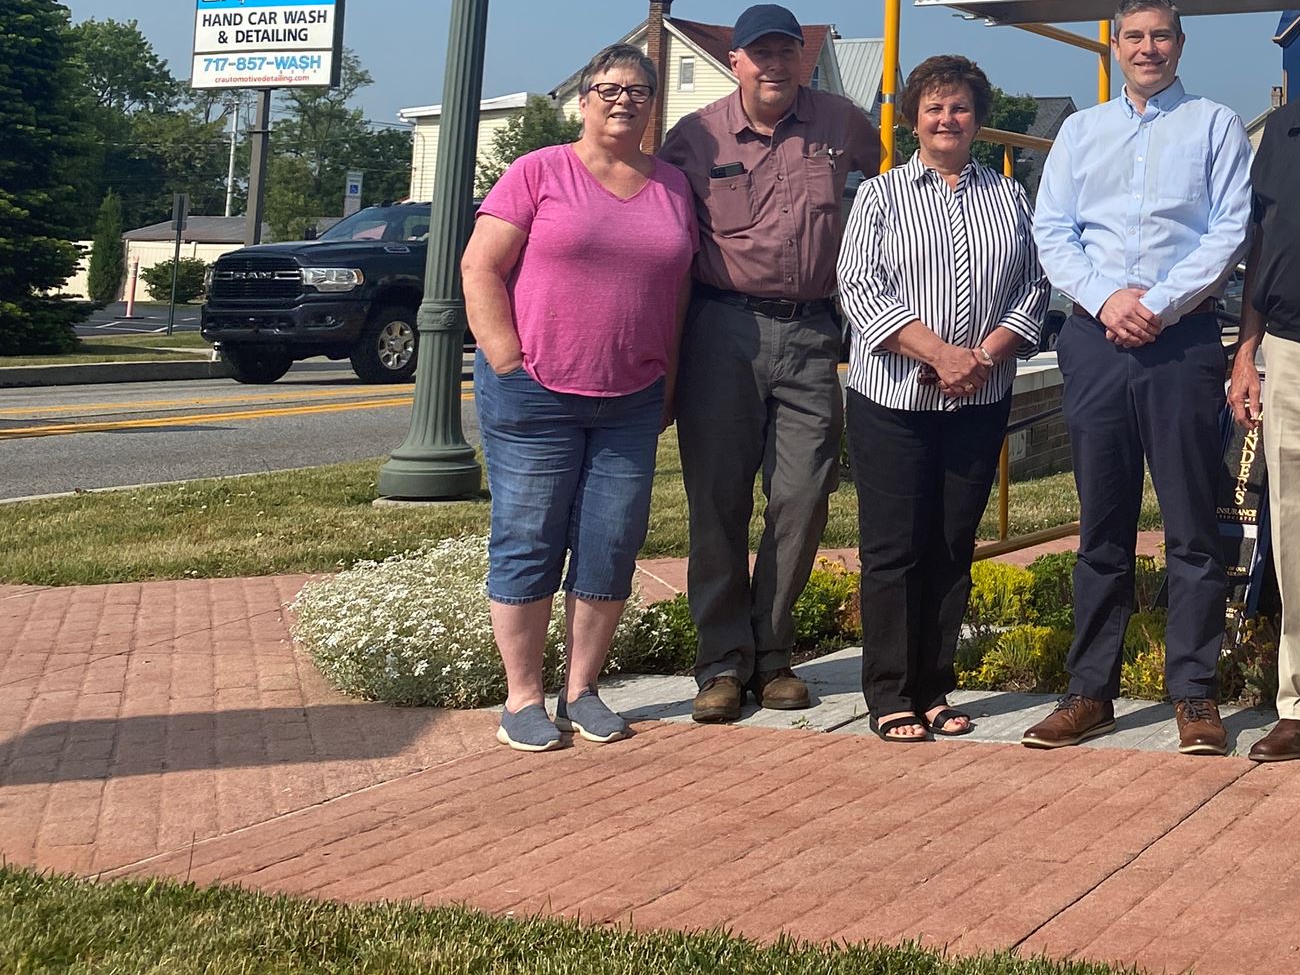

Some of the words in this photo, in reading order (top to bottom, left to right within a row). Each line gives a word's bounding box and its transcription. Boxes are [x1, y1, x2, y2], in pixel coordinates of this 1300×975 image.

[202, 12, 243, 27] HAND
[248, 11, 278, 25] CAR
[284, 9, 328, 24] WASH
[217, 30, 229, 44] &
[235, 28, 309, 43] DETAILING
[203, 55, 322, 72] 717-857-WASH
[214, 74, 310, 84] crautomotivedetailing.com
[1216, 506, 1257, 517] INSURANCE
